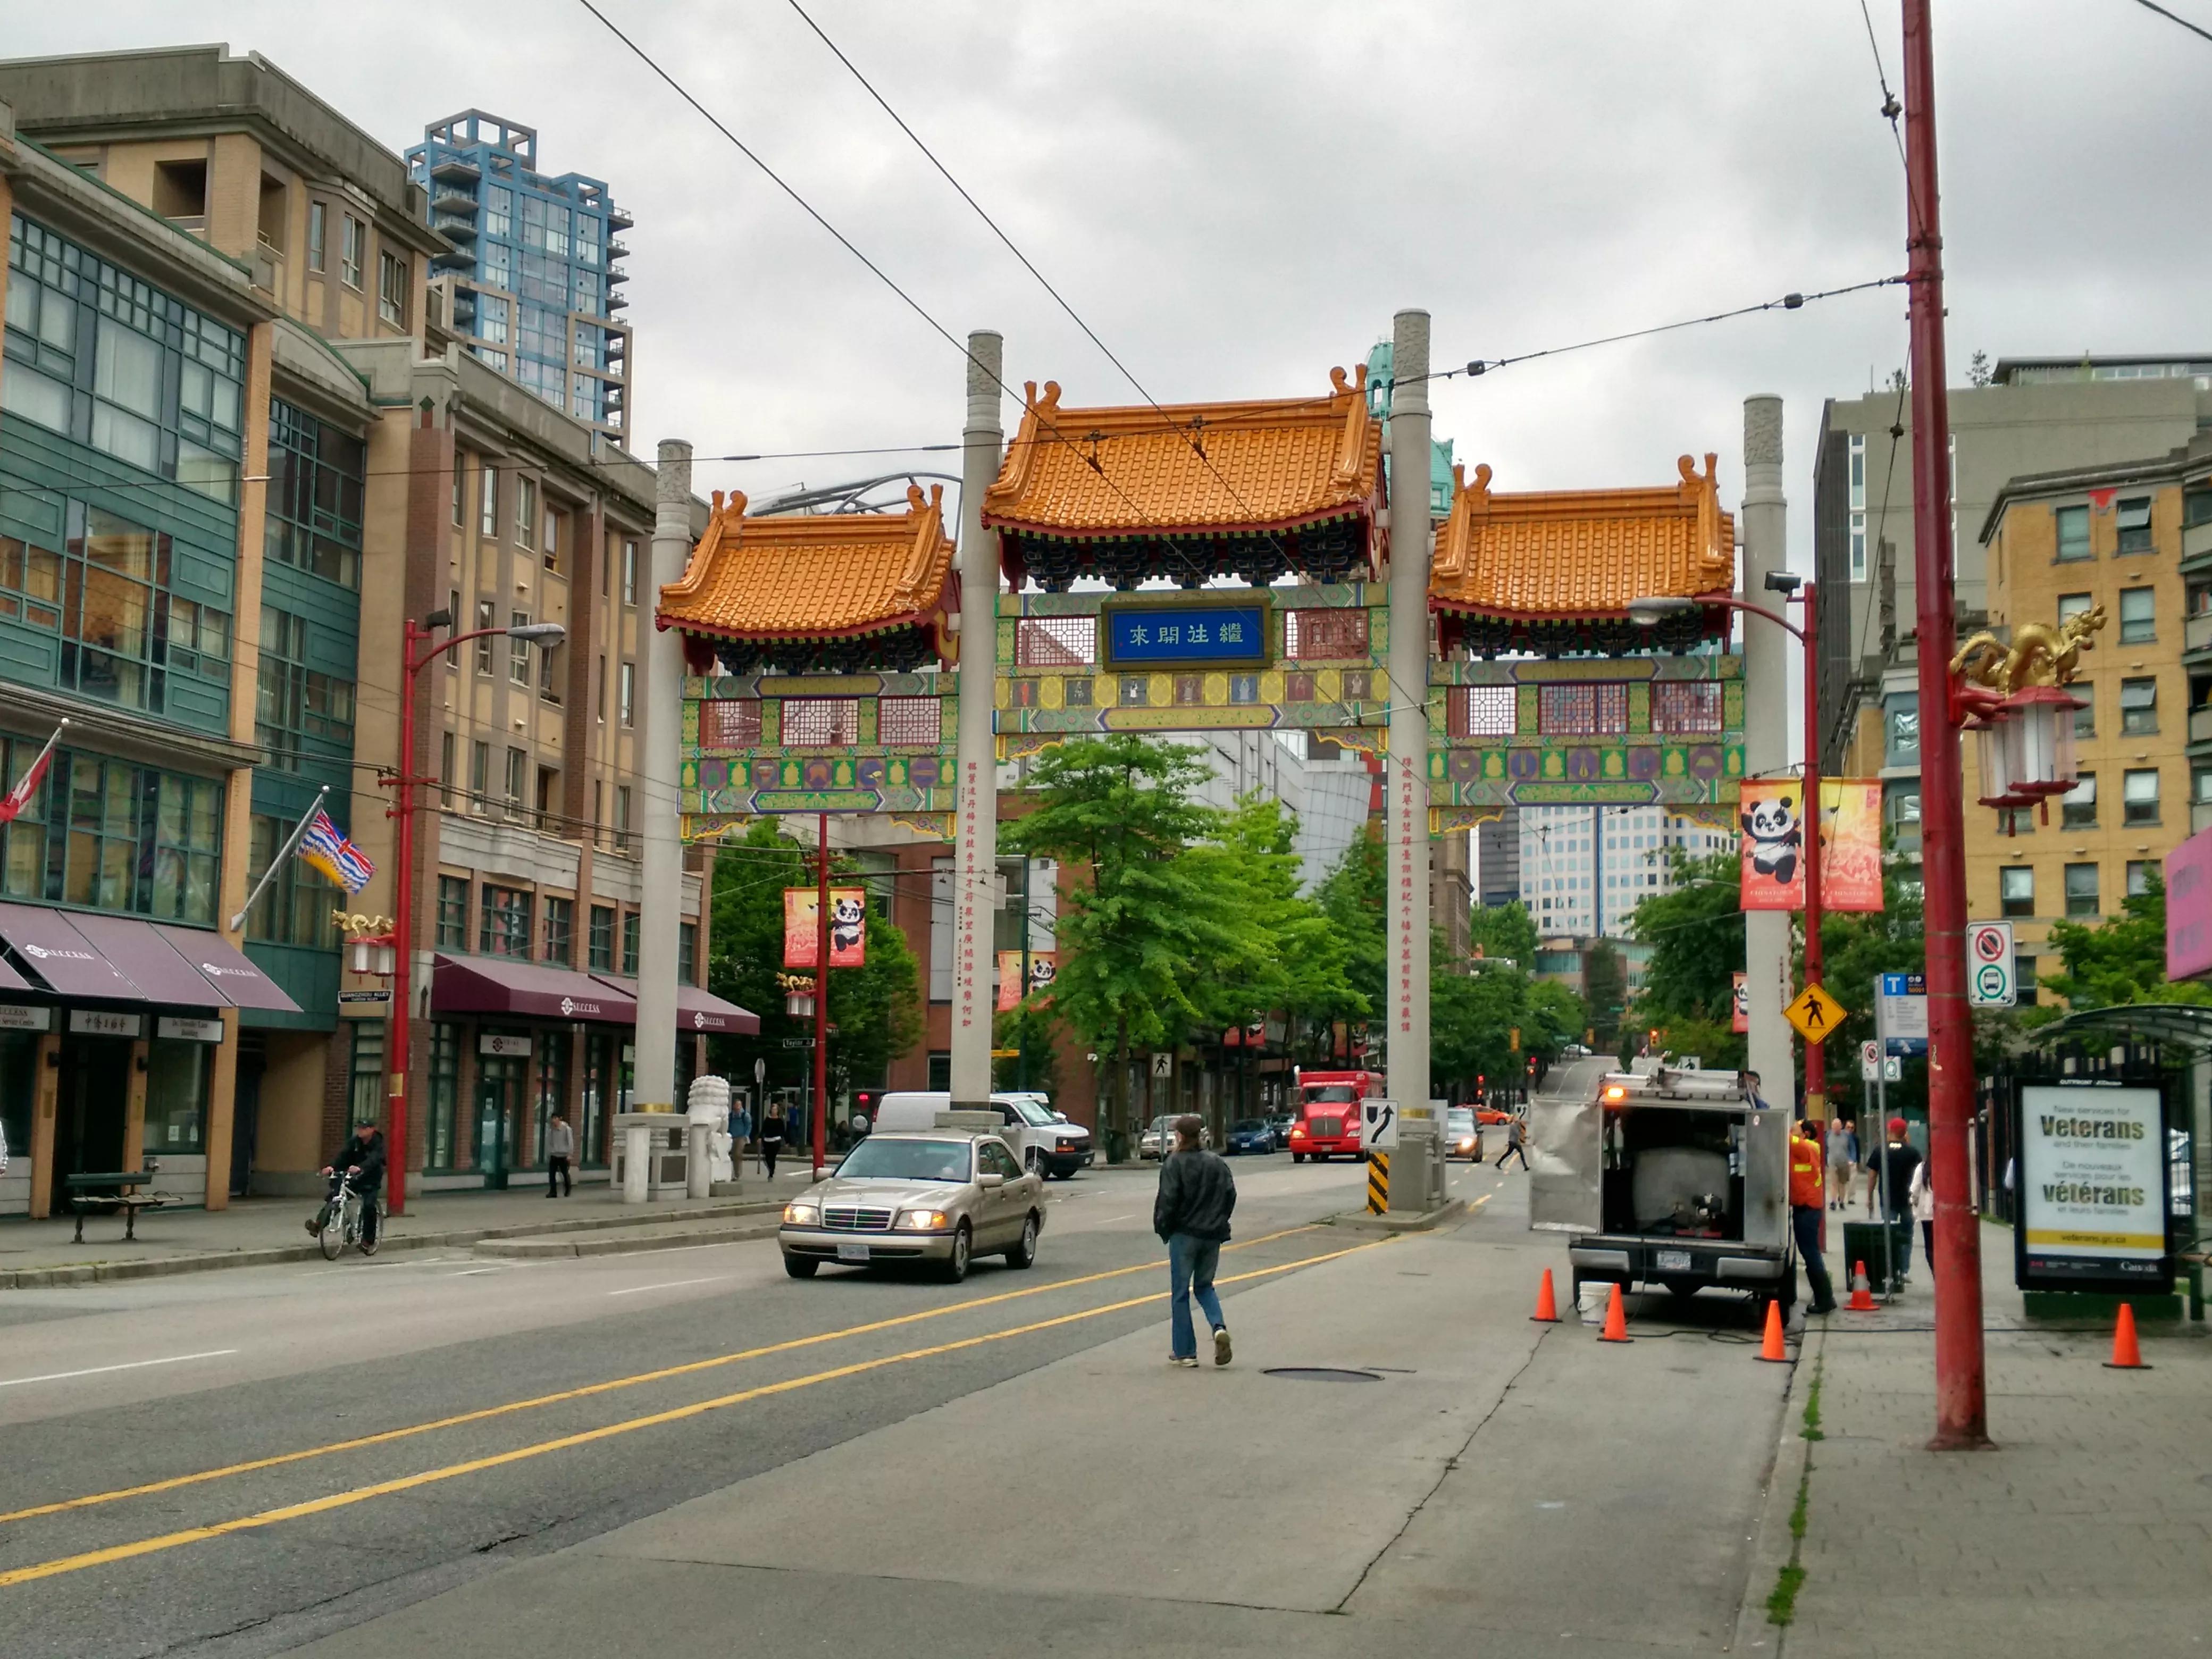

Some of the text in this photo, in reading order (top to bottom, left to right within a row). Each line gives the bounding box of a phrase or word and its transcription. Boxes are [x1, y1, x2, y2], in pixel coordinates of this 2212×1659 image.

[1888, 977, 1900, 992] T
[2077, 1106, 2115, 1115] services
[2040, 1115, 2144, 1140] Veterans
[2042, 1180, 2144, 1206] vétérans
[2062, 1234, 2126, 1244] veterans.gc.ca
